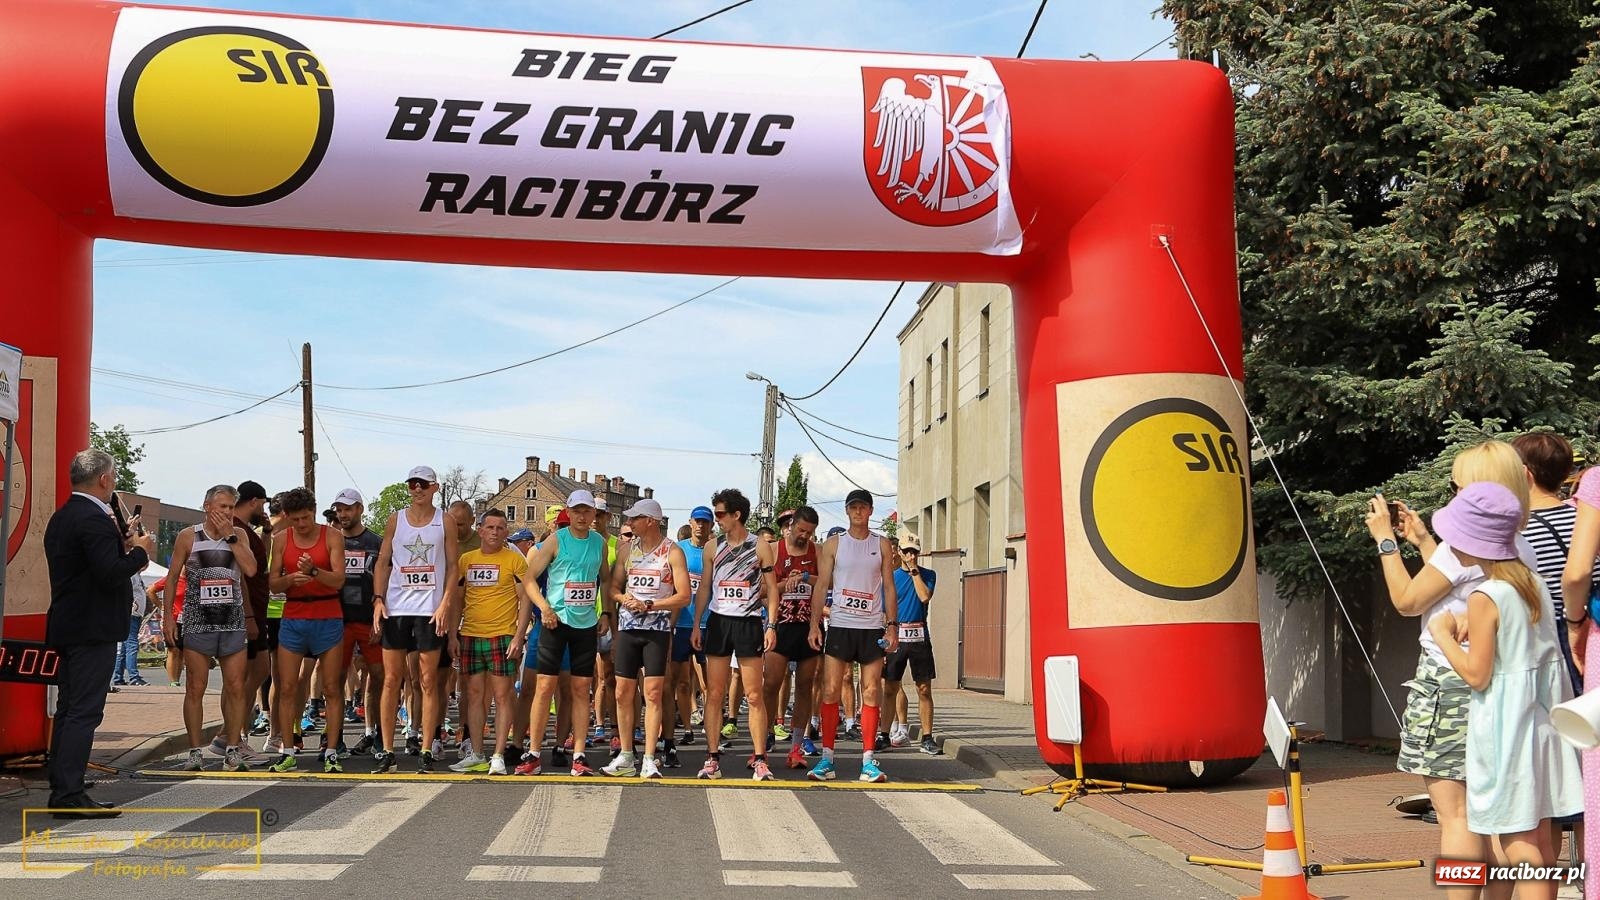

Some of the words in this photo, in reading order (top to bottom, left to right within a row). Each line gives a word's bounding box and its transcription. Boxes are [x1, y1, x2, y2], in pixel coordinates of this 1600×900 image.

[226, 48, 329, 87] SIR
[512, 48, 678, 84] BIEG
[386, 97, 533, 146] BEZ
[540, 105, 795, 157] GRANIC
[419, 169, 759, 225] RACIBÓRZ
[1172, 432, 1244, 475] SIR
[407, 574, 430, 584] 184
[473, 570, 493, 580] 143
[633, 577, 655, 588] 202
[206, 586, 228, 598] 135
[570, 590, 592, 600] 238
[723, 588, 743, 598] 136
[846, 597, 868, 609] 236
[904, 629, 919, 638] 173
